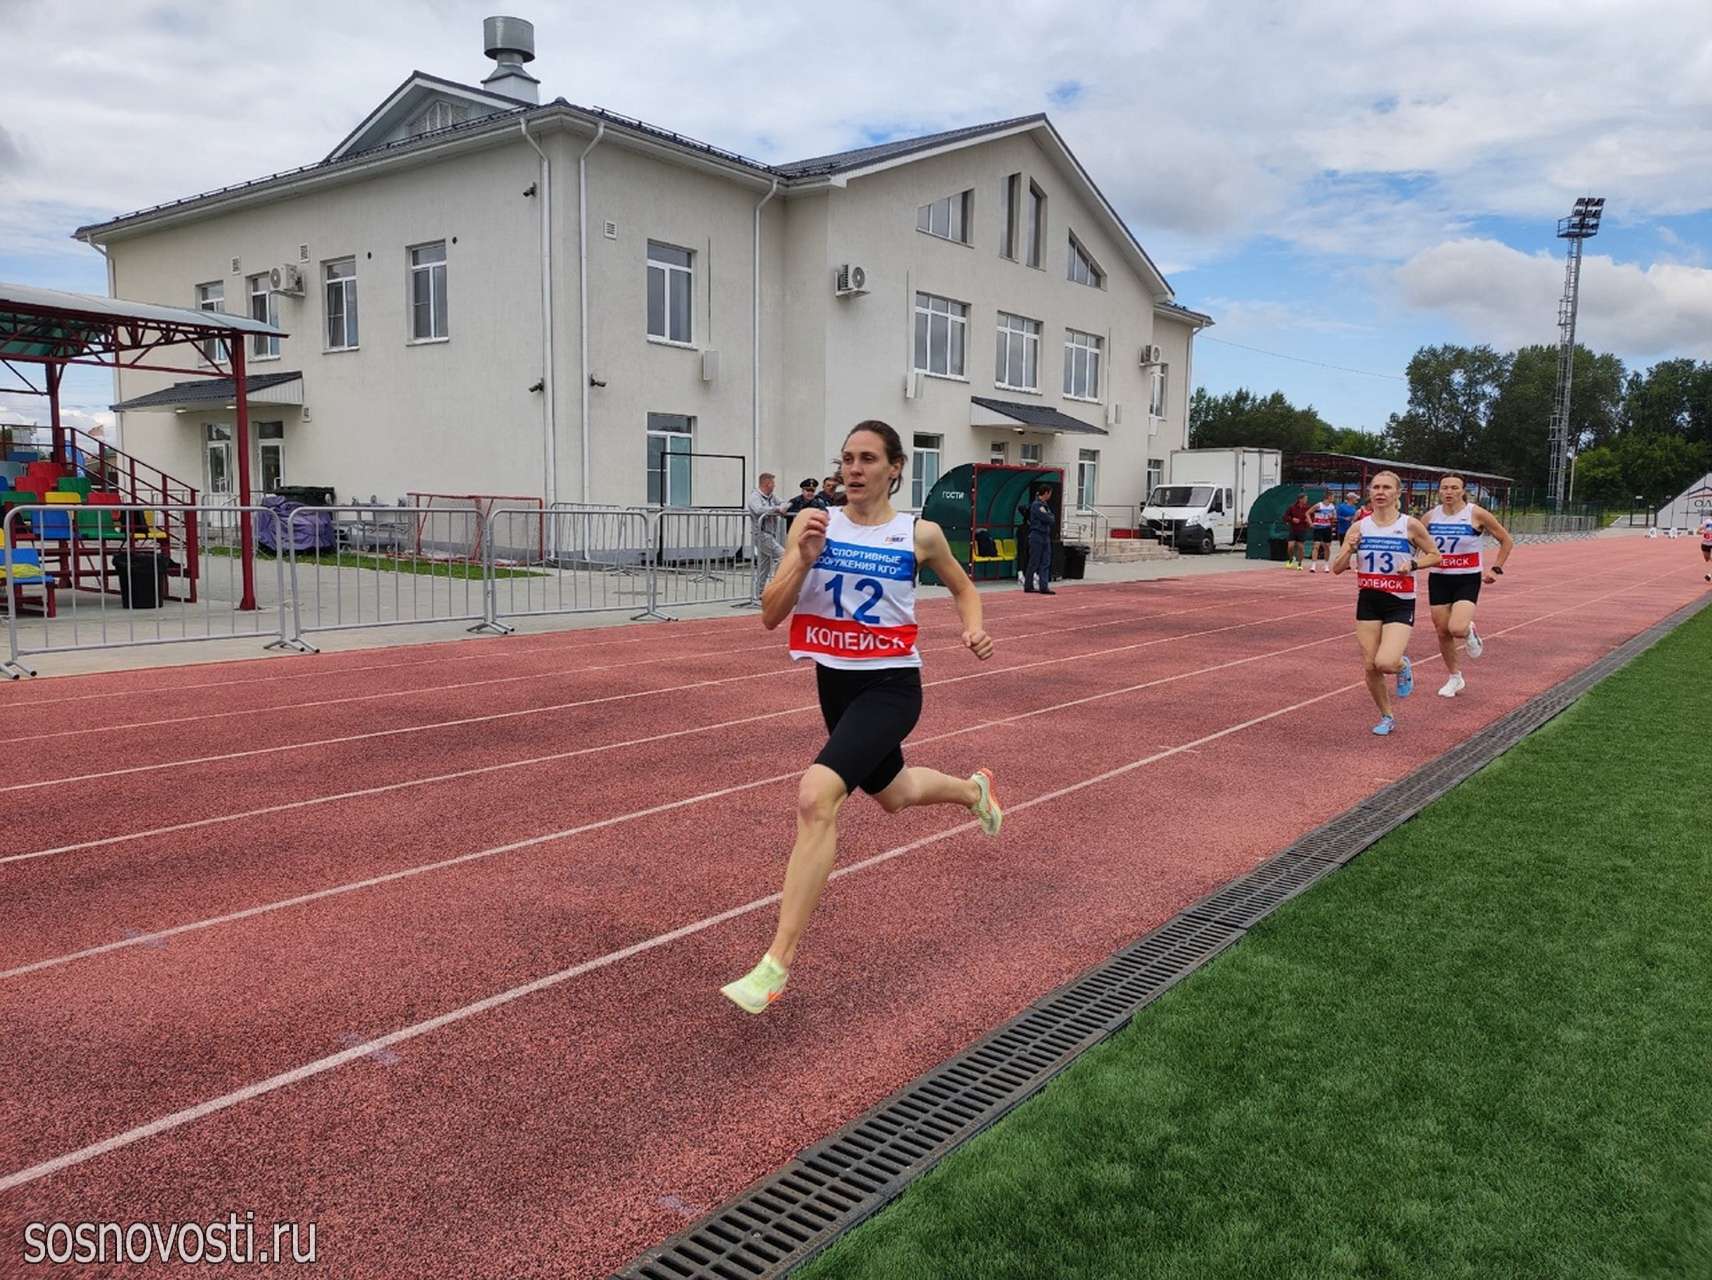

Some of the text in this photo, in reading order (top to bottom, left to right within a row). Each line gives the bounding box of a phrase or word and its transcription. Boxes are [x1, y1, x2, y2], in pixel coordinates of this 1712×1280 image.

[942, 491, 965, 500] ГОСТИ
[1435, 536, 1460, 553] 27
[816, 556, 876, 571] ООРУЖЕНИЯ
[1364, 551, 1394, 573] 13
[1440, 557, 1470, 567] ЕЙСК
[1359, 578, 1403, 590] ОПЕЙСК
[825, 573, 884, 625] 12
[806, 626, 905, 650] КОПЕЙСК
